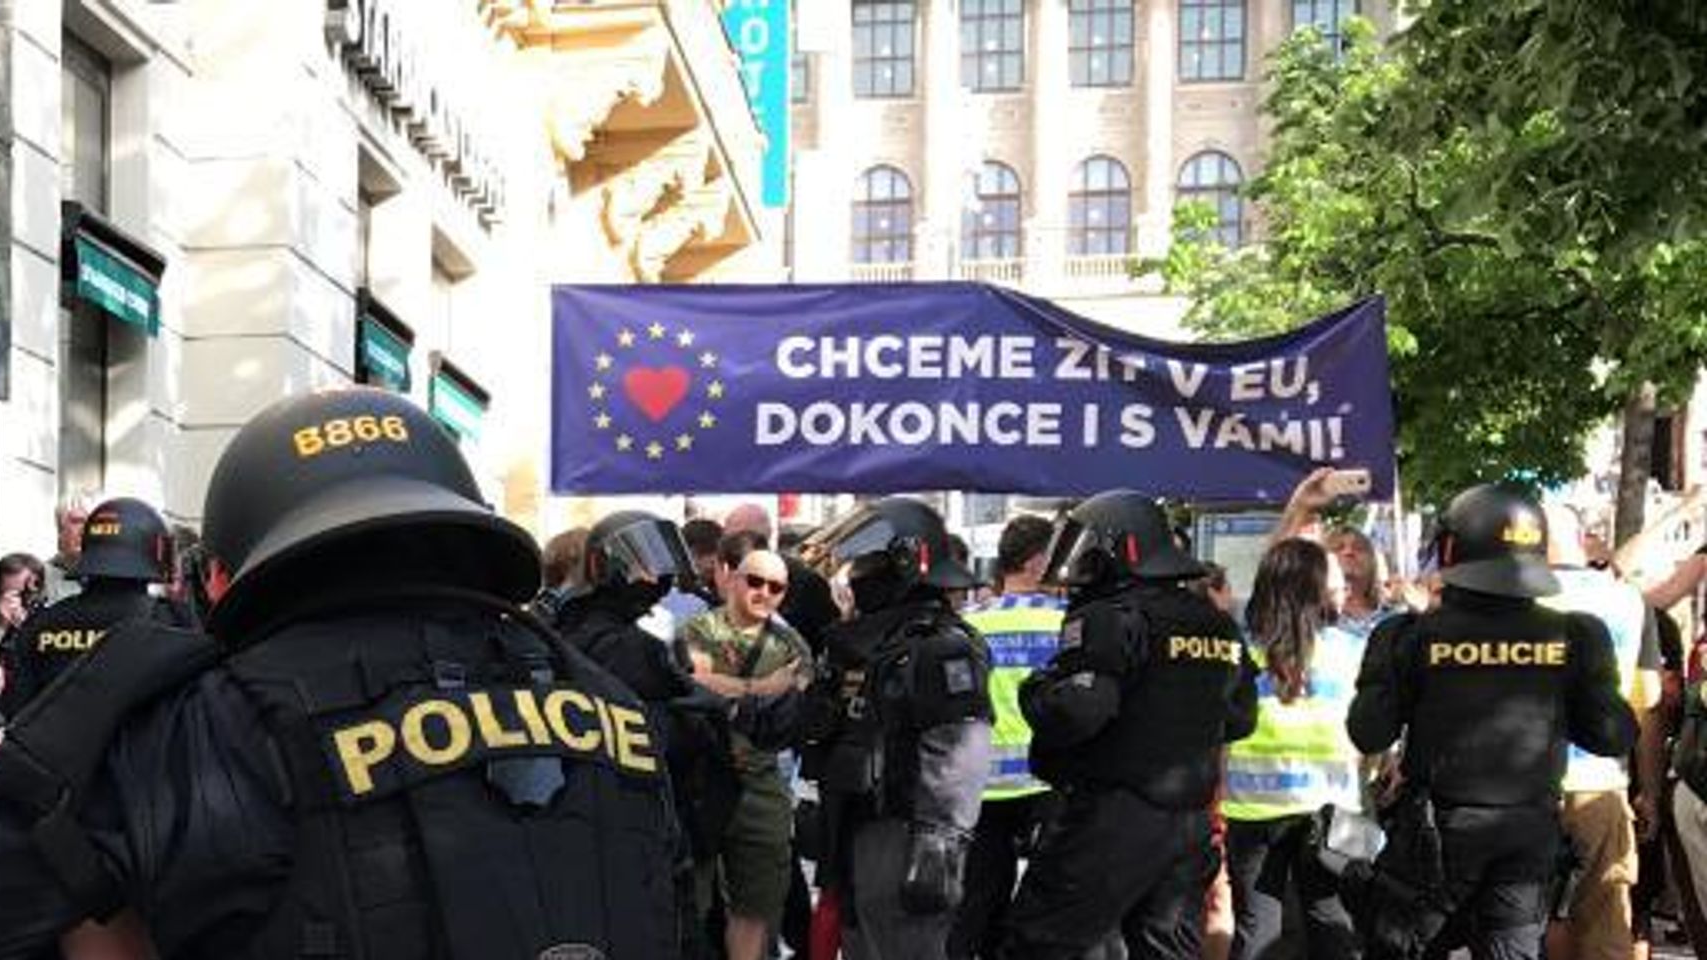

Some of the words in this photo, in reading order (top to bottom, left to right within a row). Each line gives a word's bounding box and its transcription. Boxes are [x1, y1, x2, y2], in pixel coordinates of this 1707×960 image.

[776, 336, 1036, 379] CHCEME
[1166, 360, 1209, 398] V
[1230, 356, 1320, 405] EU,
[294, 415, 409, 456] B866
[756, 402, 1063, 445] DOKONCE
[1083, 403, 1099, 447] I
[1120, 403, 1156, 448] S
[36, 628, 108, 654] POLI
[1430, 642, 1567, 665] POLICIE
[333, 689, 656, 795] POLICIE
